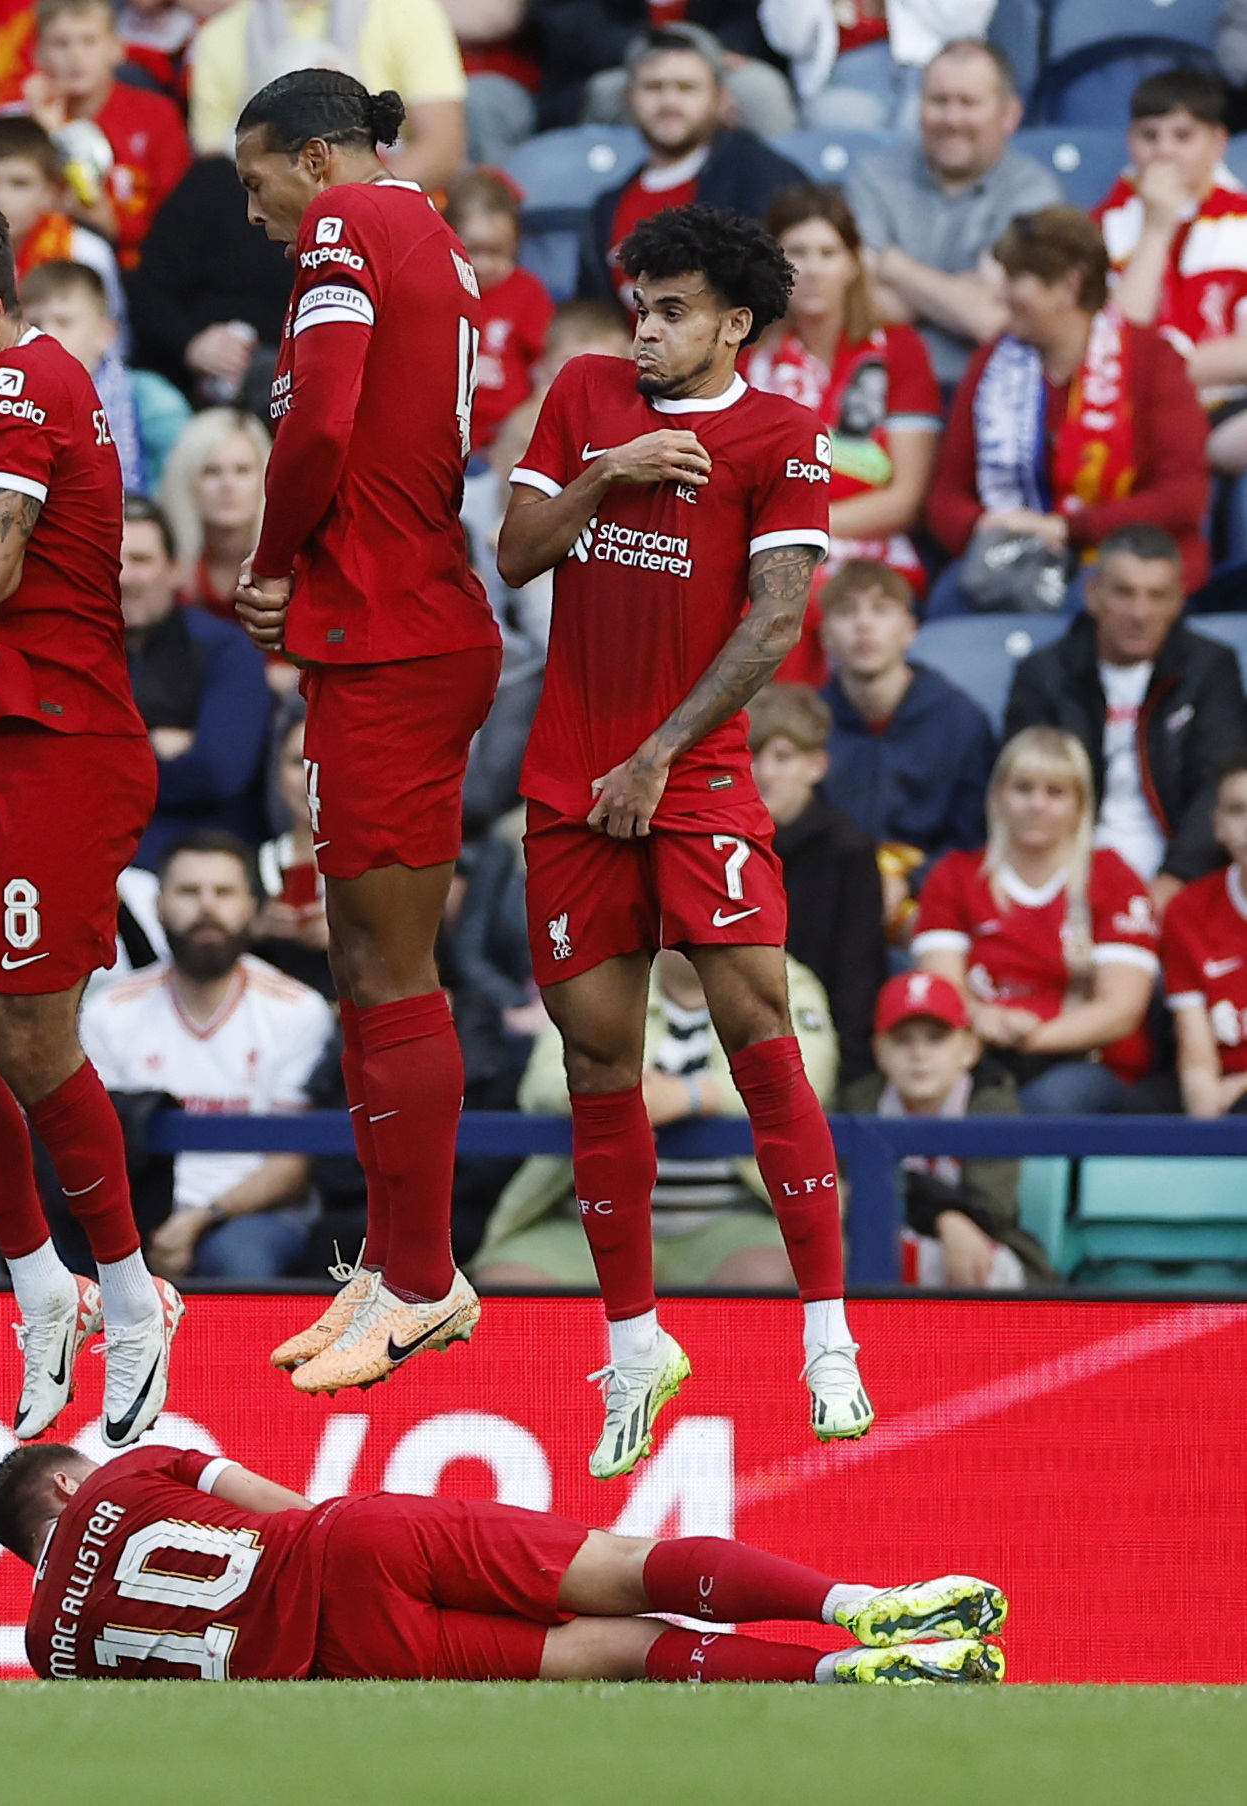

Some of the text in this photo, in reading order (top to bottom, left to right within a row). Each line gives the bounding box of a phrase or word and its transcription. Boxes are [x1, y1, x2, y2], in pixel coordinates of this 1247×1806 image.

[594, 542, 692, 578] chartered
[598, 522, 689, 557] standard
[713, 835, 751, 900] 7
[4, 878, 41, 950] 8
[578, 1199, 613, 1215] FC
[782, 1173, 835, 1196] LFC
[49, 1499, 127, 1681] MAC ALLISTER
[94, 1517, 265, 1681] 10
